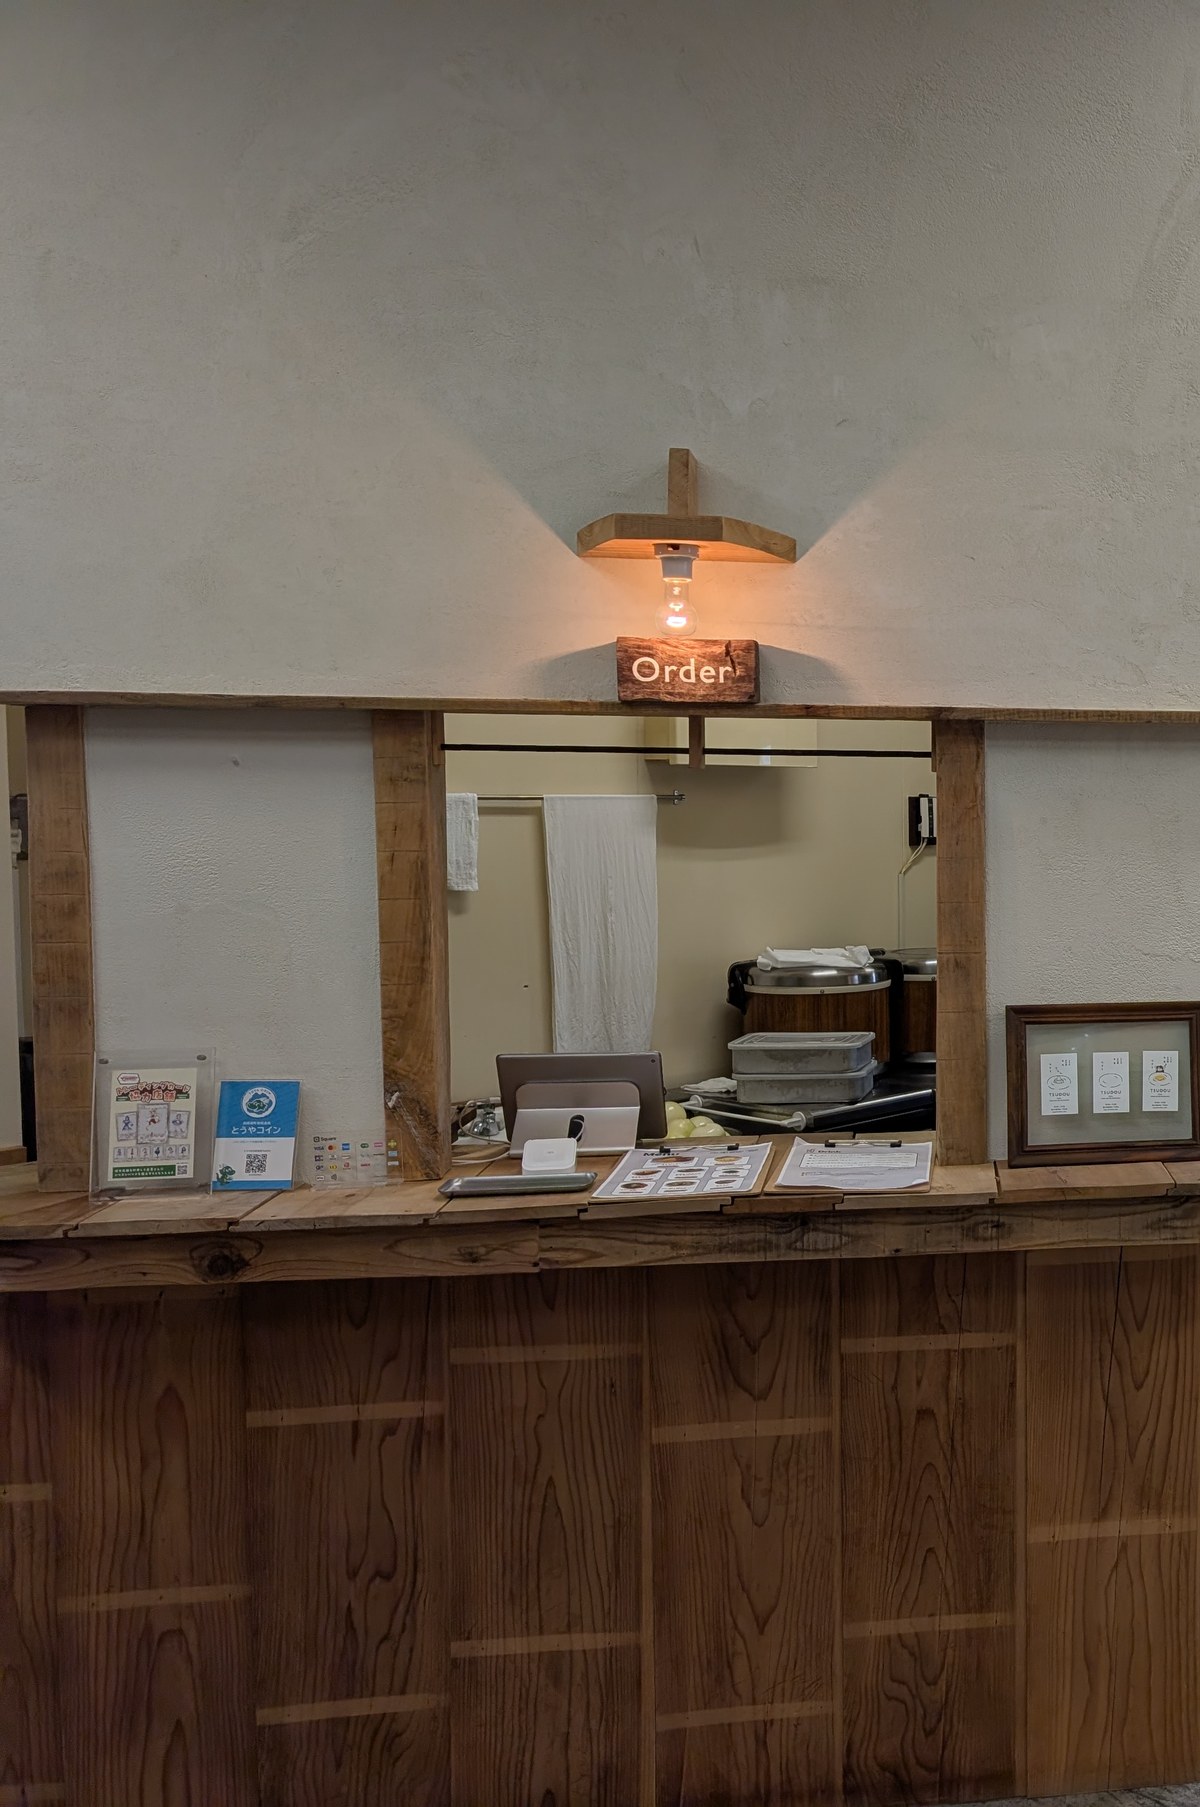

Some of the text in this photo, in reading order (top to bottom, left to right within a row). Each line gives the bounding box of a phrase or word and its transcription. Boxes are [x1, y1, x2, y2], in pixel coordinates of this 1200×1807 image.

[632, 657, 732, 683] Order
[116, 1081, 191, 1096] トレーディングカード
[129, 1089, 176, 1103] 協力店舗
[231, 1126, 281, 1135] とうやコイン
